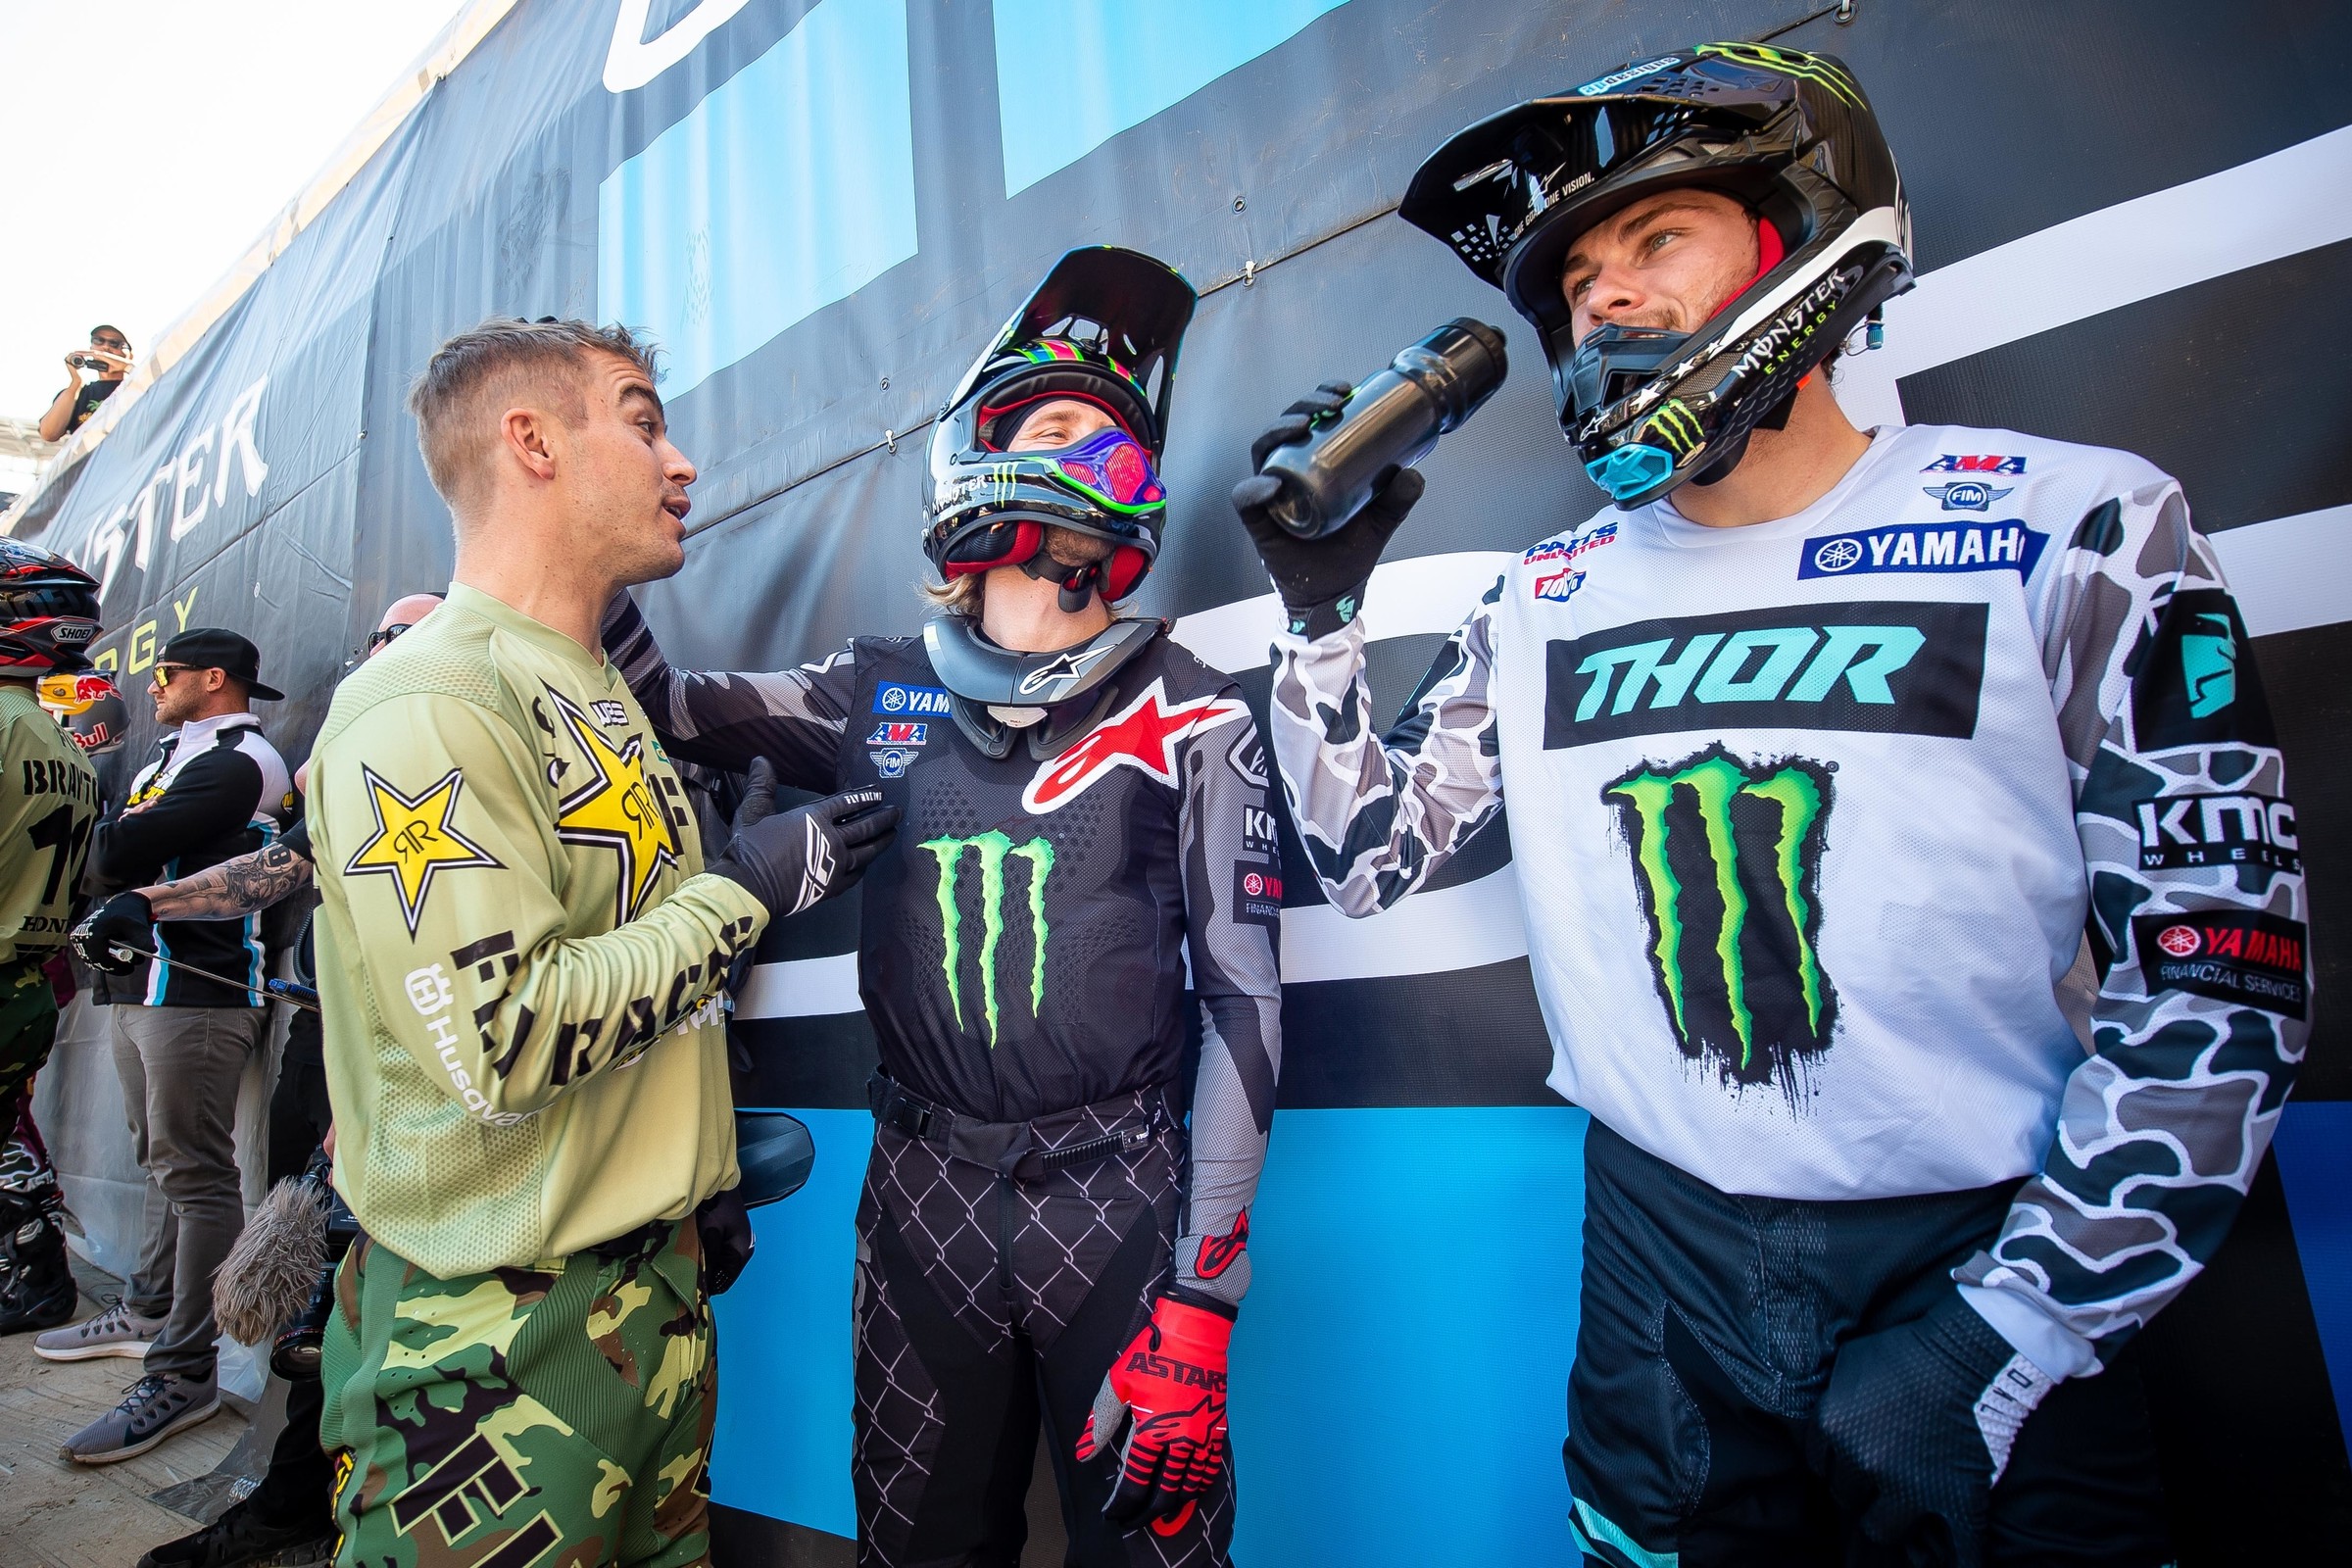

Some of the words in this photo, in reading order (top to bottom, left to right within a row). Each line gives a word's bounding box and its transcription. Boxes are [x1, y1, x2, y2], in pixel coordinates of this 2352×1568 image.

[1544, 190, 1560, 210] ONE
[1561, 172, 1595, 197] VISION.
[1731, 268, 1845, 378] MONSTER
[1764, 300, 1837, 374] ENERGY
[1921, 454, 2028, 475] AMA
[1951, 489, 1983, 502] FIM
[59, 627, 91, 640] SHOEI
[1574, 624, 1927, 723] THOR
[866, 722, 928, 744] AMA
[885, 758, 901, 769] FIM
[2145, 848, 2301, 870] WHEELS
[2205, 927, 2302, 972] YAMAHA
[2160, 963, 2241, 990] FINANCIAL
[2243, 973, 2302, 1004] SERVICES
